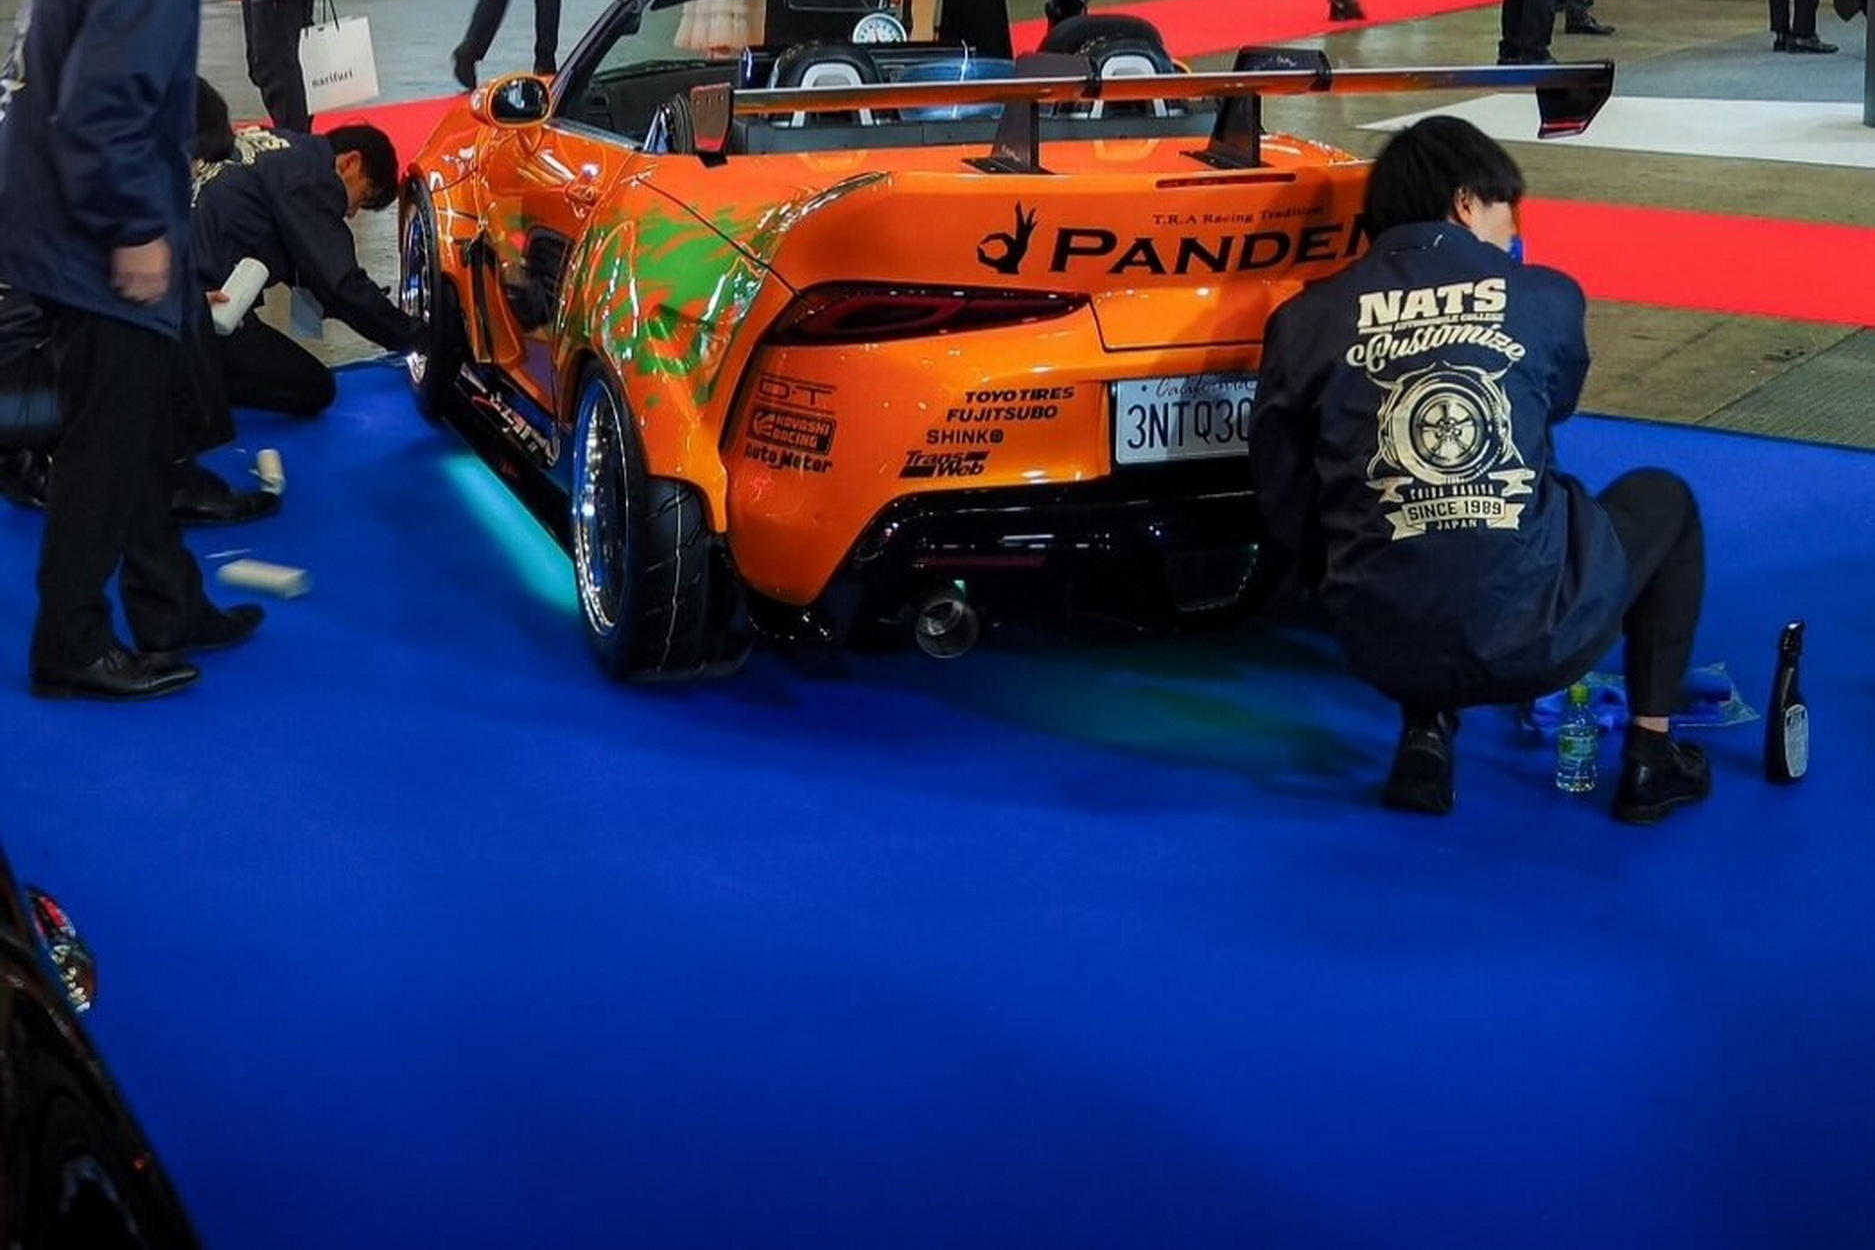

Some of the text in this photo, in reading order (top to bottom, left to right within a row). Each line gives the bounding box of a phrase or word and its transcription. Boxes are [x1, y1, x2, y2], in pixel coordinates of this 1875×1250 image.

[1357, 277, 1507, 327] NATS
[1346, 323, 1526, 373] Customize
[945, 405, 1059, 423] FUJITSUBO
[926, 428, 1004, 445] SHINKO
[1407, 499, 1502, 521] SINCE 1989
[1436, 518, 1478, 530] JAPAN
